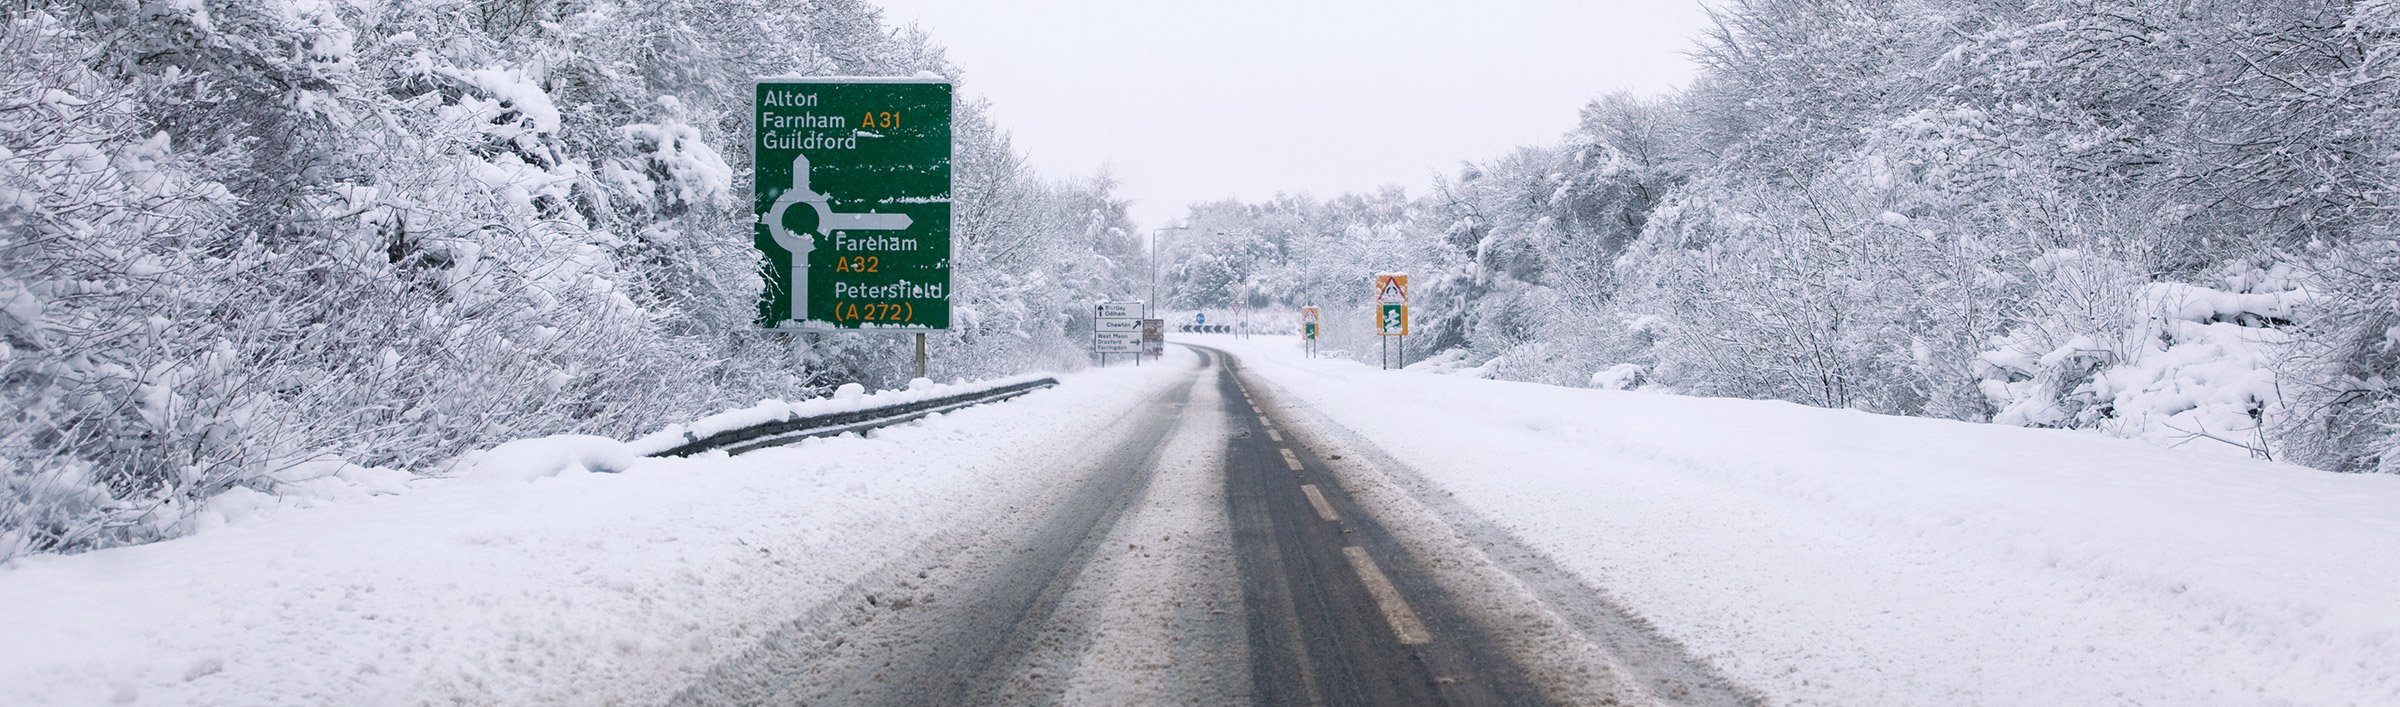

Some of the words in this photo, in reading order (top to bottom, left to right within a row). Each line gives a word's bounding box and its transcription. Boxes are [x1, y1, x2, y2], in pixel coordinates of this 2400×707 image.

[764, 90, 818, 107] Alton
[763, 111, 845, 128] Farnham
[862, 112, 901, 129] A31
[763, 131, 857, 150] Guildford
[835, 234, 918, 252] Fareham
[836, 256, 879, 273] A32
[835, 281, 942, 299] Petersfield
[835, 301, 913, 322] (A272)
